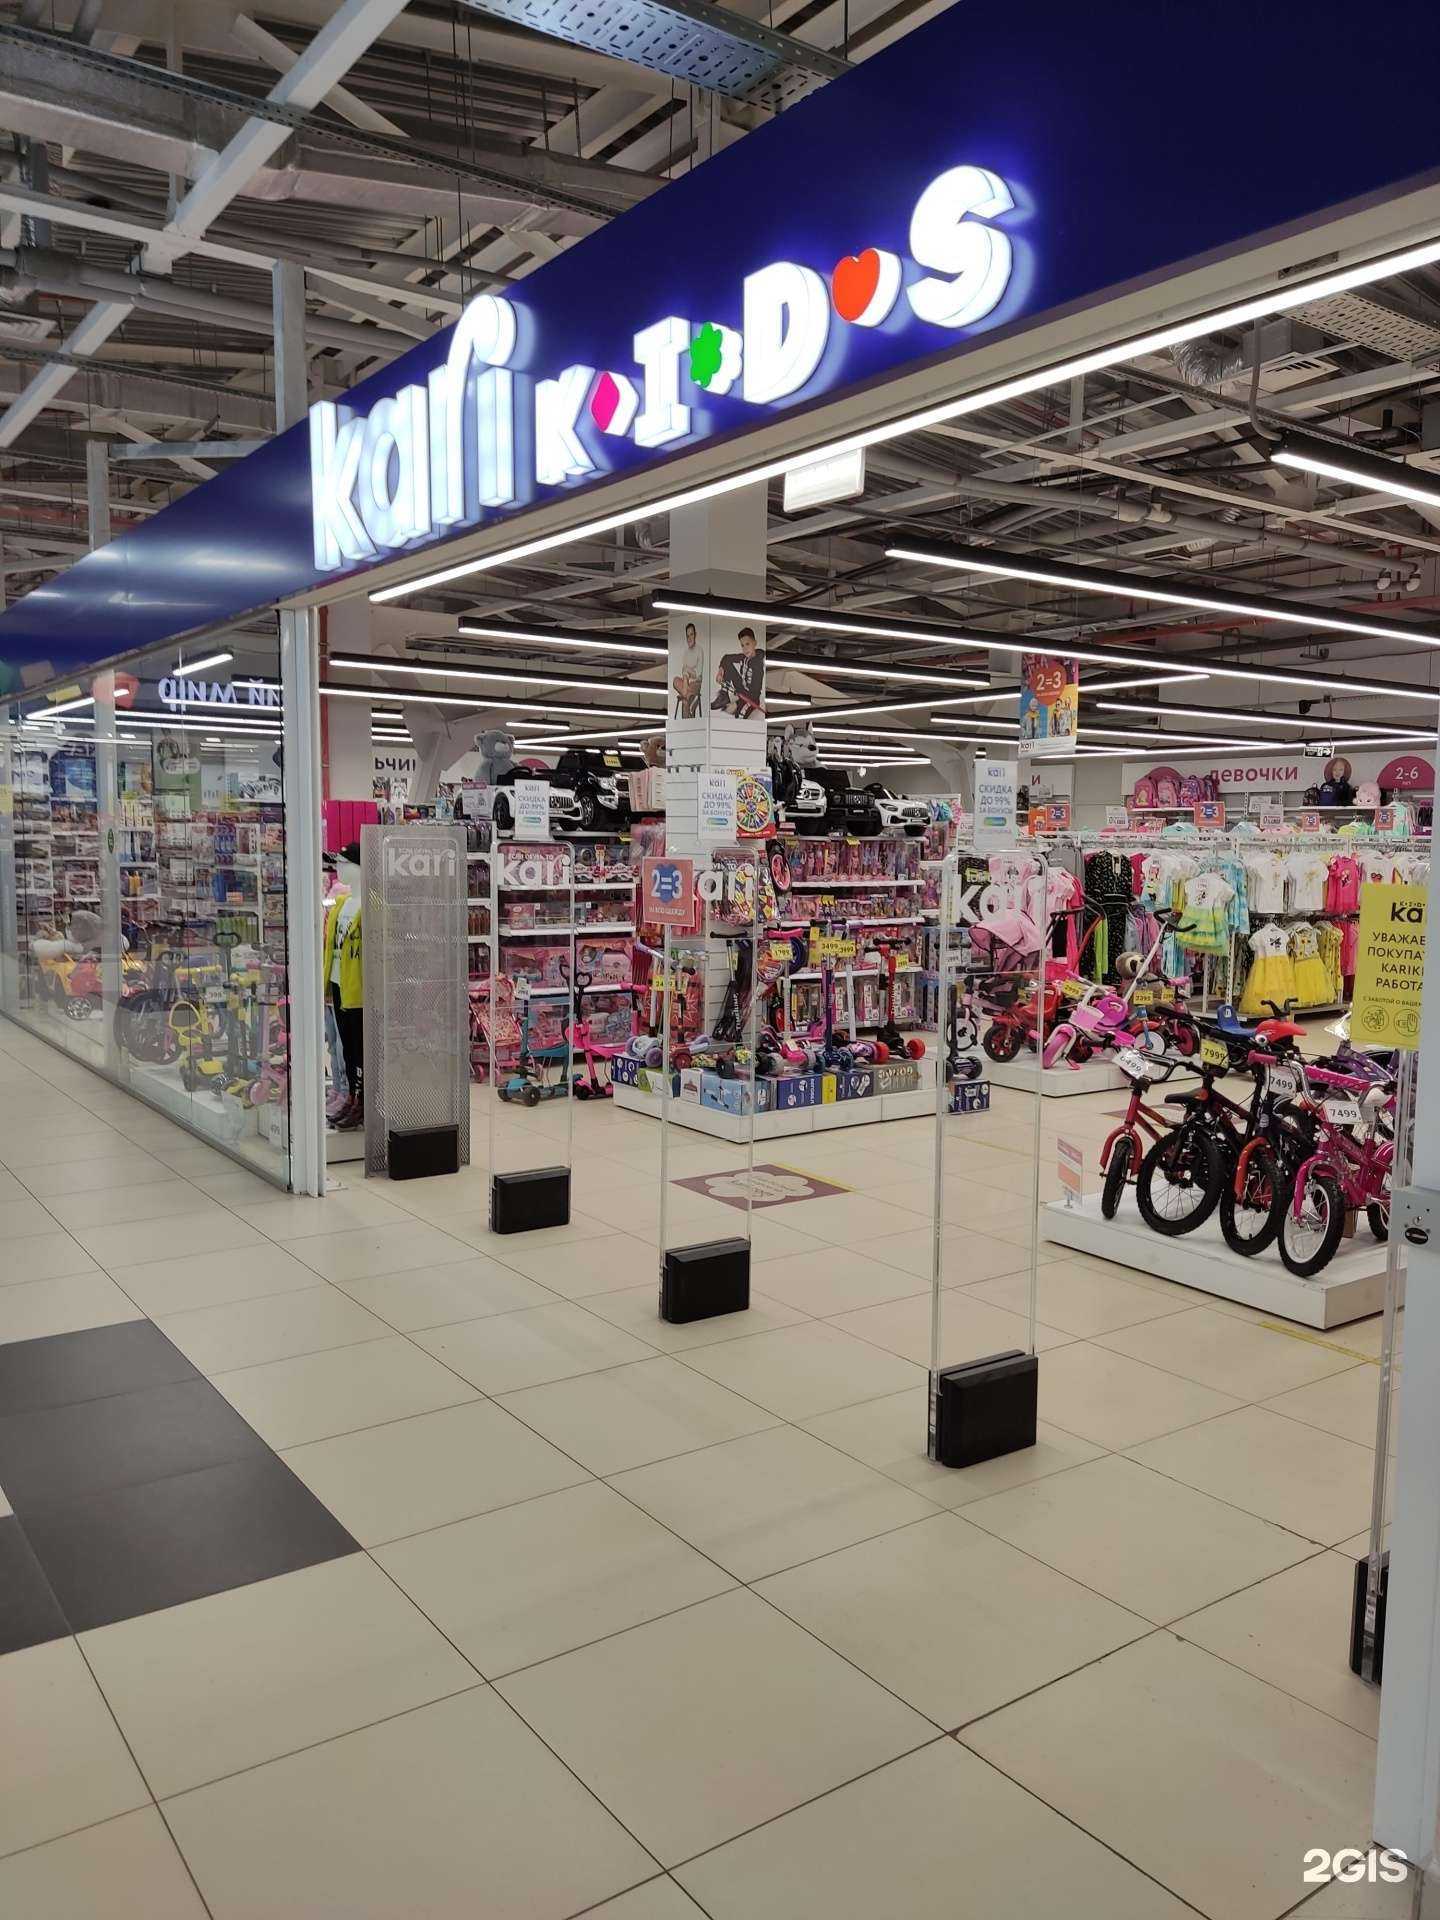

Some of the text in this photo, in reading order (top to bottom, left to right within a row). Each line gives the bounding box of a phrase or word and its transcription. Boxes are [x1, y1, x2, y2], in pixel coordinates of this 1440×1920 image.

[310, 294, 518, 572] kari
[1035, 671, 1062, 691] 2=3
[1395, 766, 1418, 780] 2-6
[702, 792, 733, 801] СКИДКА
[978, 784, 1013, 794] СКИДКА
[703, 801, 715, 810] ДО
[980, 796, 993, 805] ДО
[1050, 809, 1066, 819] 2=3
[1200, 807, 1219, 818] 2=3
[388, 847, 456, 877] kari
[497, 852, 571, 886] kari
[650, 868, 683, 900] 2=3
[698, 862, 755, 902] ari
[1372, 931, 1426, 947] УВАЖАЕ
[1203, 1047, 1225, 1062] 7999
[1269, 1075, 1293, 1091] 7499
[1329, 1108, 1357, 1119] 7499
